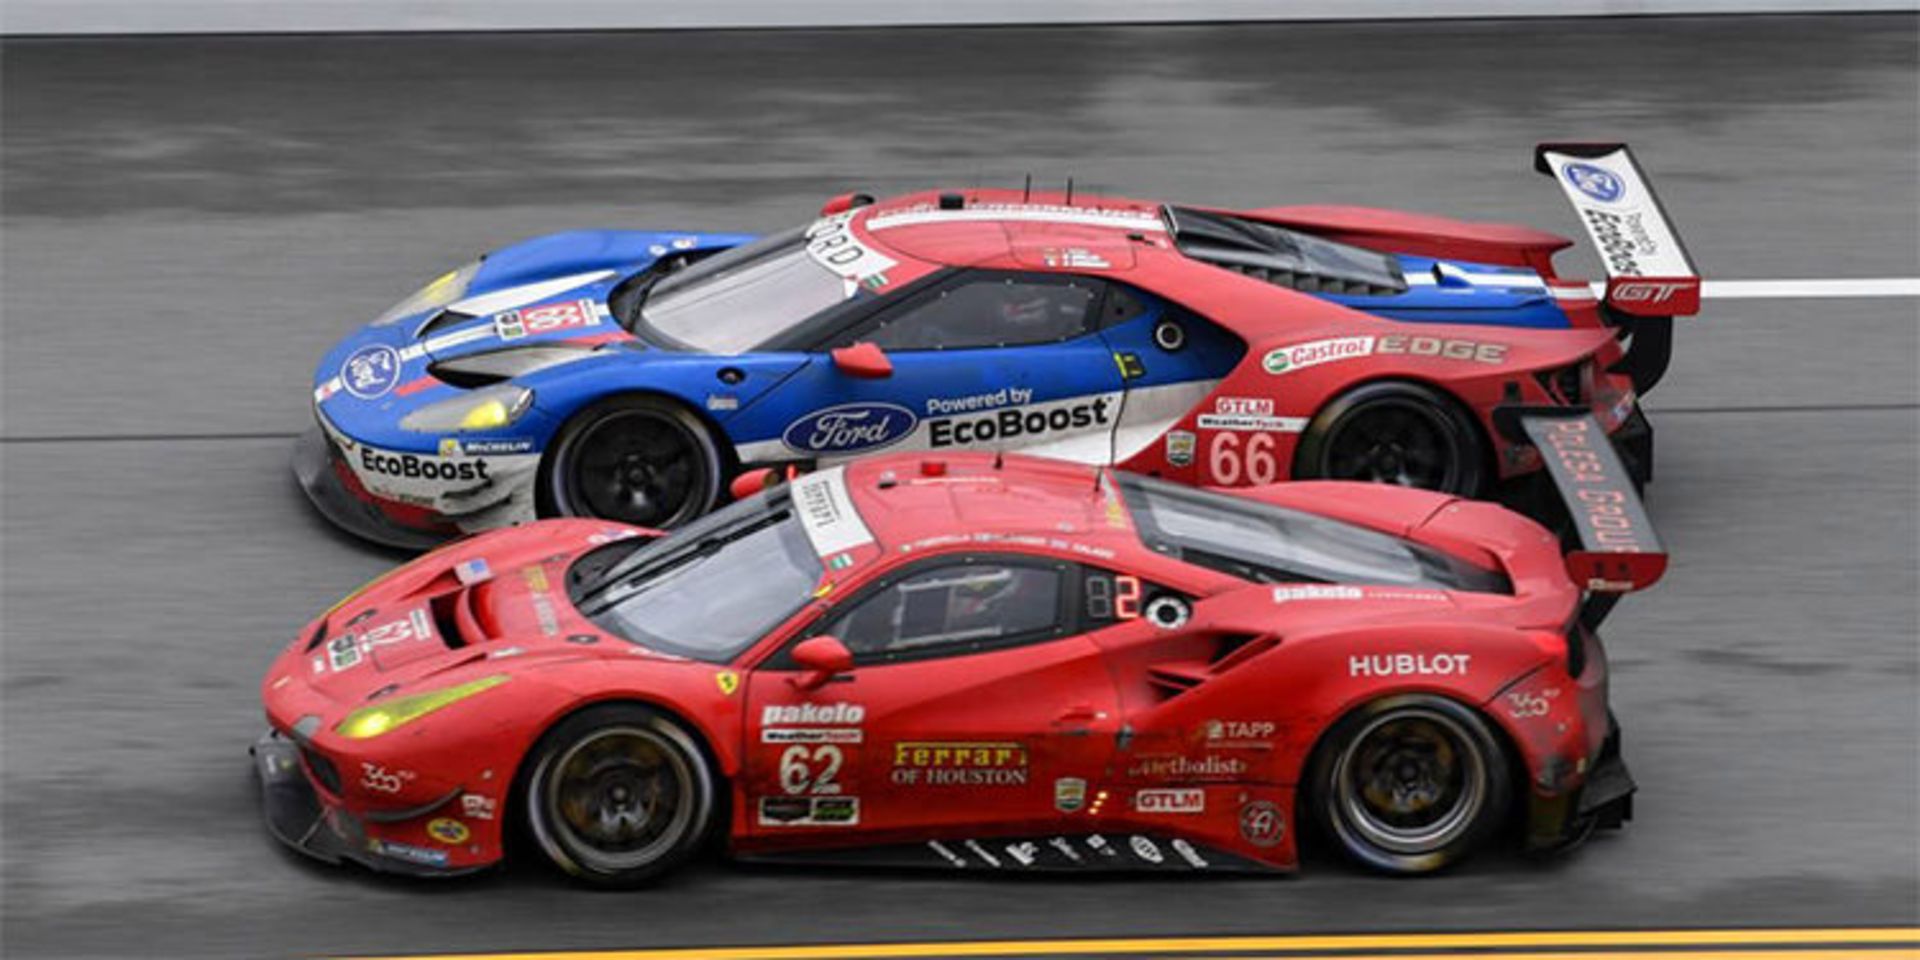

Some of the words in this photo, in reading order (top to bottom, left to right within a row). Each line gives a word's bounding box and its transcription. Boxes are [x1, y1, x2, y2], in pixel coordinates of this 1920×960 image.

[1612, 283, 1698, 303] GT
[1291, 339, 1367, 364] Castrol
[1376, 334, 1509, 365] EDGE
[927, 393, 1006, 414] Powered
[1010, 386, 1034, 405] by
[1218, 400, 1271, 415] GTLM
[808, 410, 890, 449] Ford
[928, 398, 1109, 448] EcoBoost
[360, 448, 489, 481] EcoBoost
[1210, 431, 1276, 487] 66
[1350, 654, 1471, 676] HUBLOT
[1227, 720, 1276, 738] TAPP
[894, 742, 1028, 766] Ferrari
[780, 744, 844, 794] 62
[891, 769, 918, 785] OF
[926, 768, 1028, 785] HOUSTON
[1140, 793, 1202, 808] GTLM
